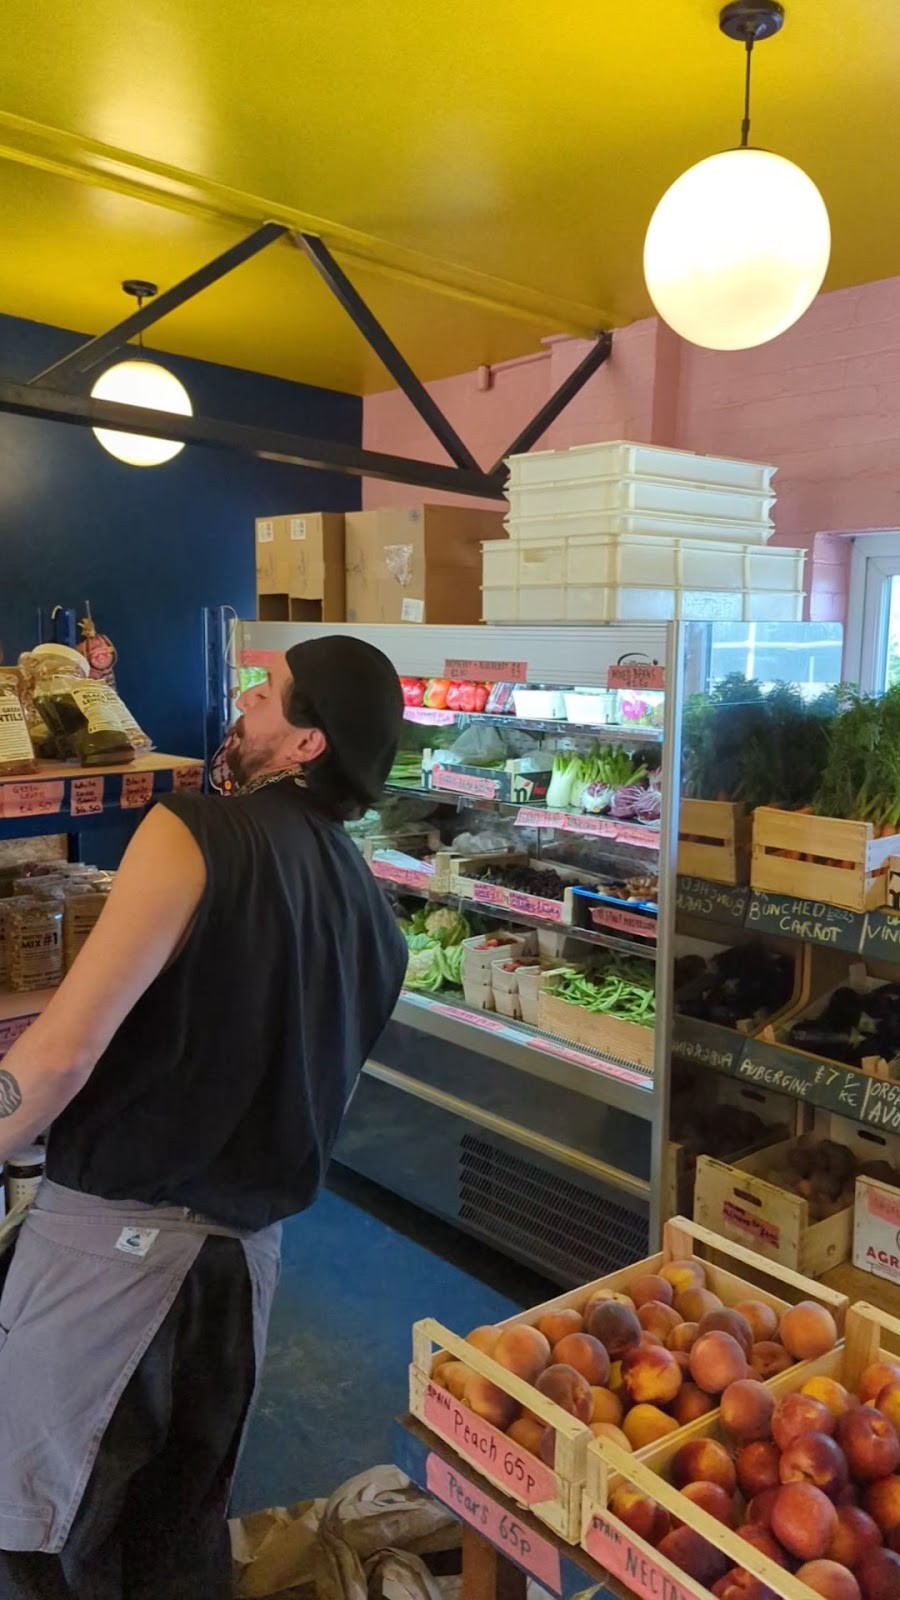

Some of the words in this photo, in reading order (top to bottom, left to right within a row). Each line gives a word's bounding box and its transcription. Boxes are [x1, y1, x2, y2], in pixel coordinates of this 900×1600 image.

[749, 899, 826, 920] BUNCHED
[22, 939, 41, 948] MIX
[780, 916, 843, 942] CARROT
[740, 1058, 812, 1096] AUBERGINE
[454, 1409, 497, 1463] Peach
[447, 1471, 489, 1525] Pears
